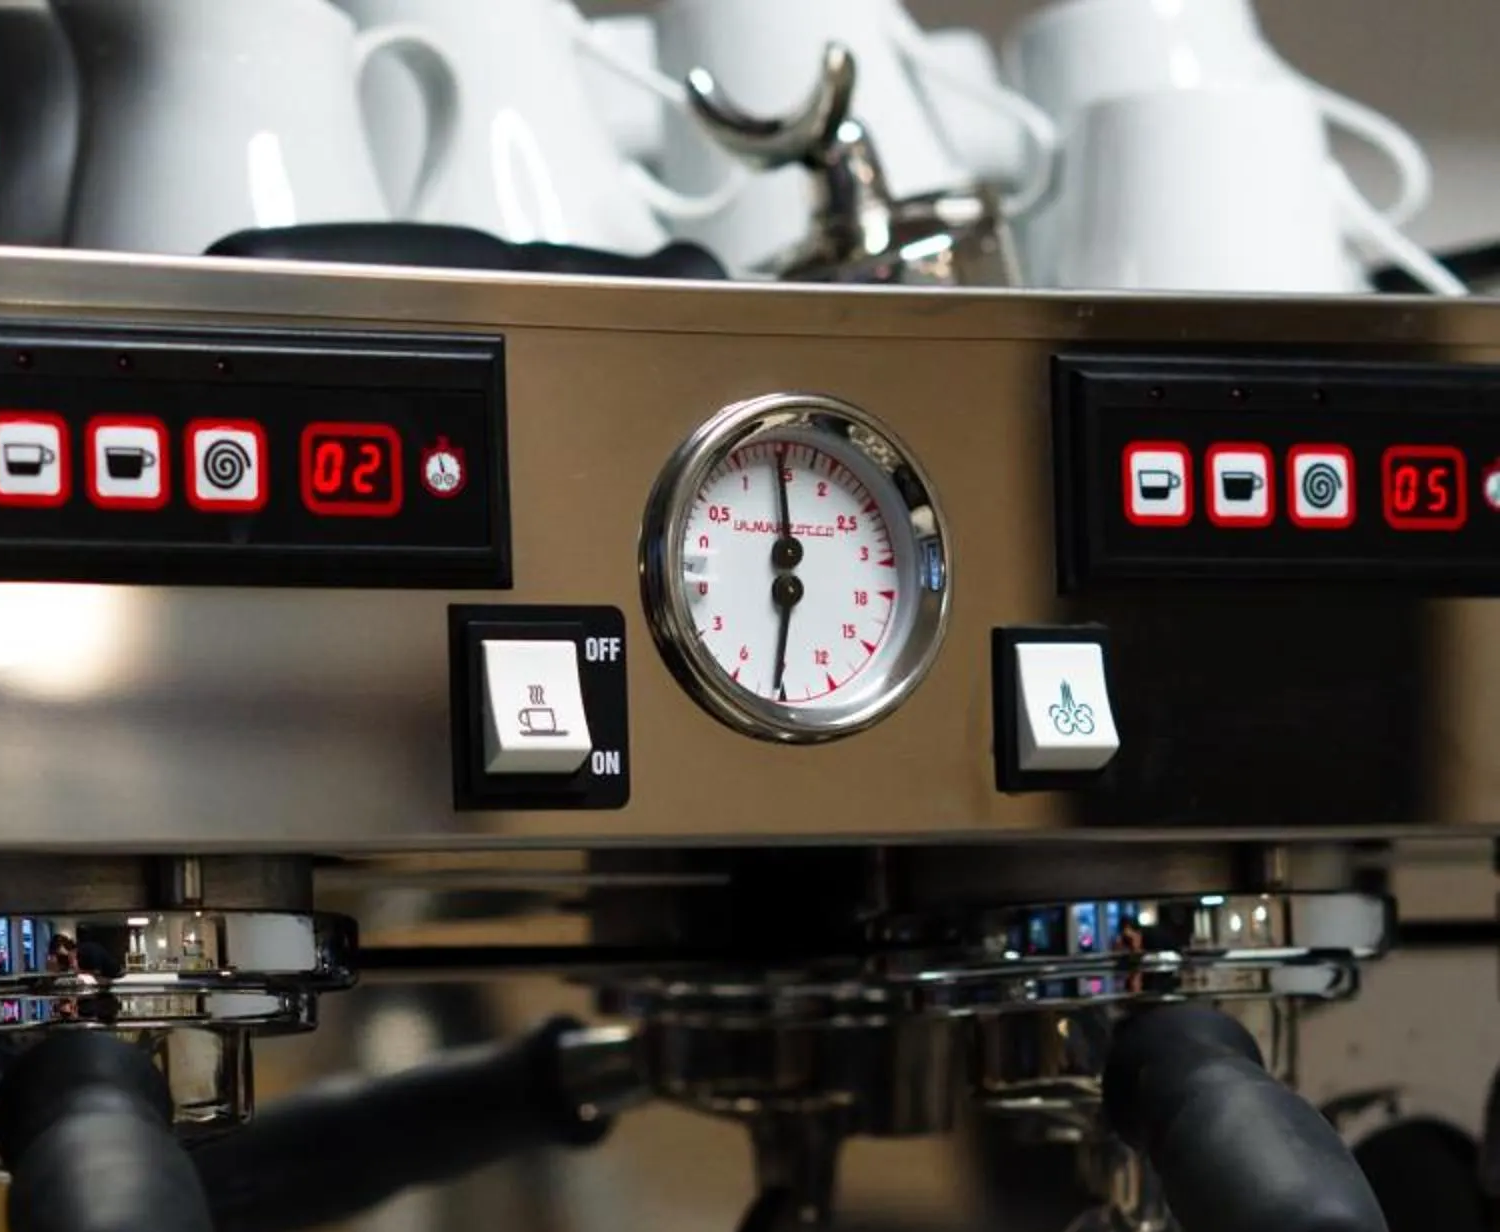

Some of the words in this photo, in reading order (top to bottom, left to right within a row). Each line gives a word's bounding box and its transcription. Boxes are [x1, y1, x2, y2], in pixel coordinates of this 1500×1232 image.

[312, 441, 381, 494] 02
[817, 481, 828, 497] 2
[1393, 465, 1448, 512] 05
[708, 505, 731, 524] 0,5
[753, 520, 835, 537] MAROCCO
[836, 514, 858, 533] 2,5
[859, 546, 869, 561] 3
[853, 591, 868, 606] 18
[712, 615, 723, 631] 3
[841, 623, 857, 639] 15
[585, 637, 621, 662] OFF
[739, 644, 749, 660] 6
[813, 649, 830, 665] 12
[591, 751, 621, 776] ON
